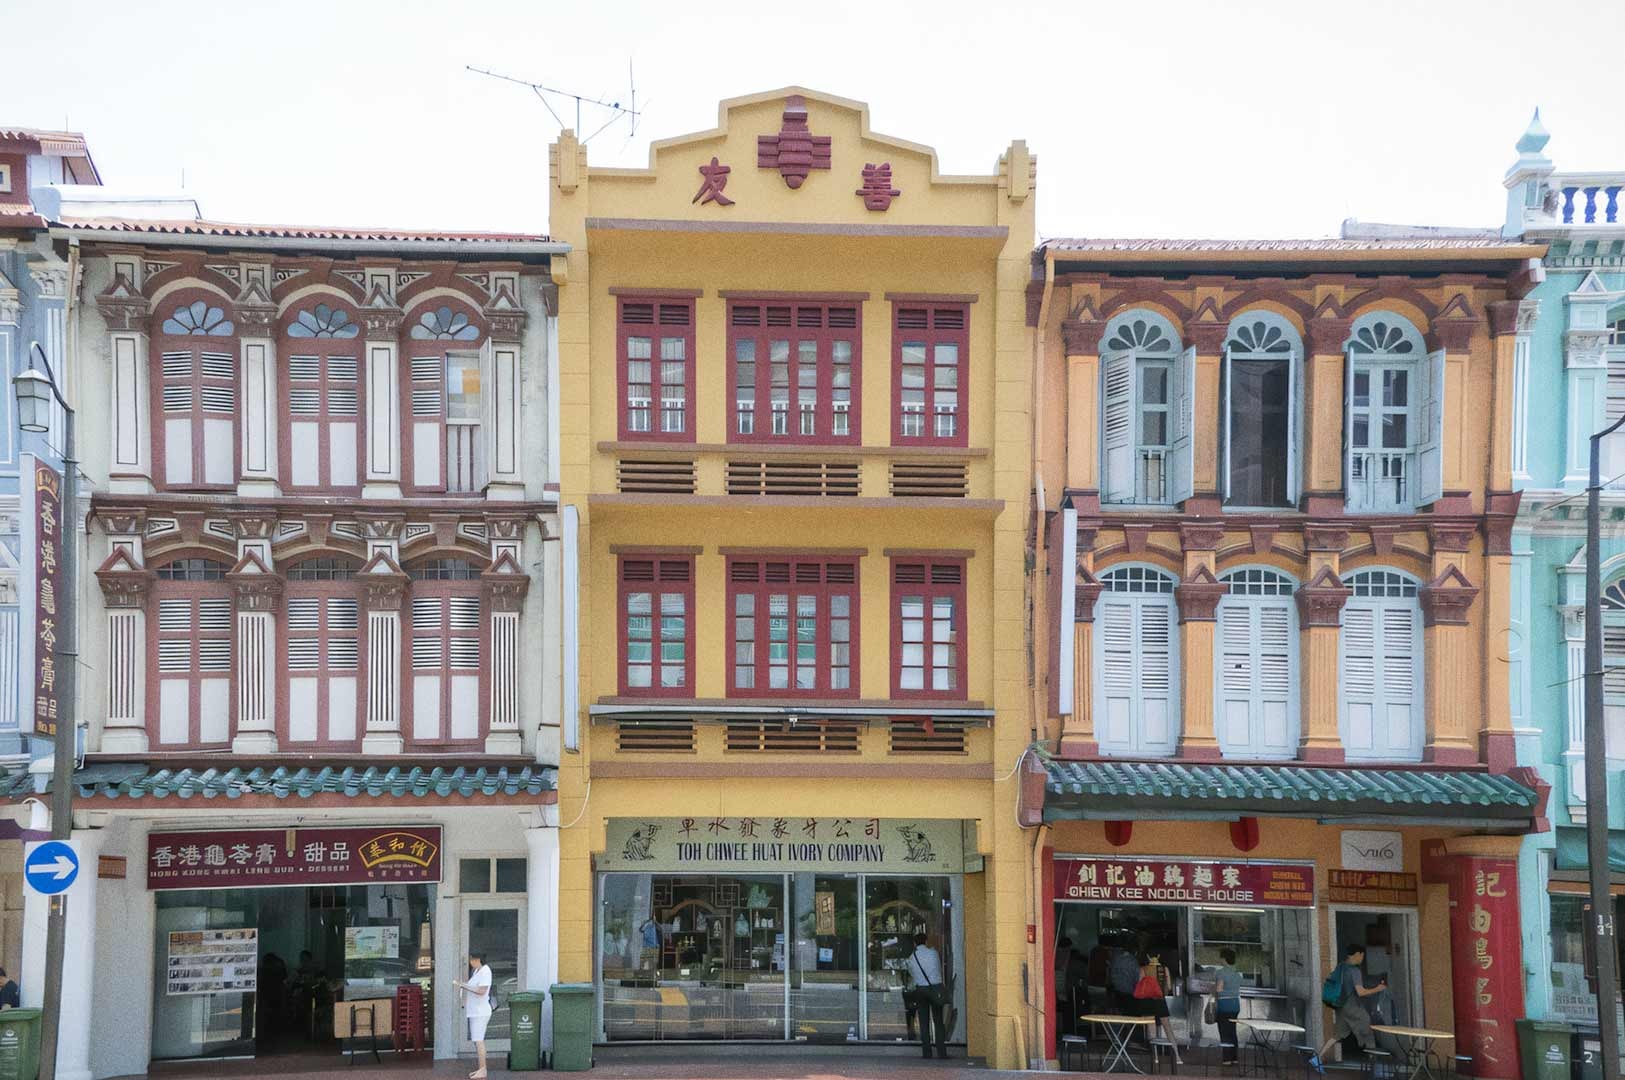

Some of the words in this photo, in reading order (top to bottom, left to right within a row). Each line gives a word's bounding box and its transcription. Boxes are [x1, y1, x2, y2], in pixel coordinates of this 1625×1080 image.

[303, 841, 350, 863] 甜品
[676, 842, 701, 861] TOH
[706, 842, 748, 861] CHWEE
[752, 842, 783, 861] HUAT
[788, 843, 824, 861] IVORY
[828, 843, 886, 862] COMPANY
[1116, 887, 1144, 899] KEE
[1147, 888, 1203, 900] NOODLE
[1207, 889, 1254, 901] HOUSE
